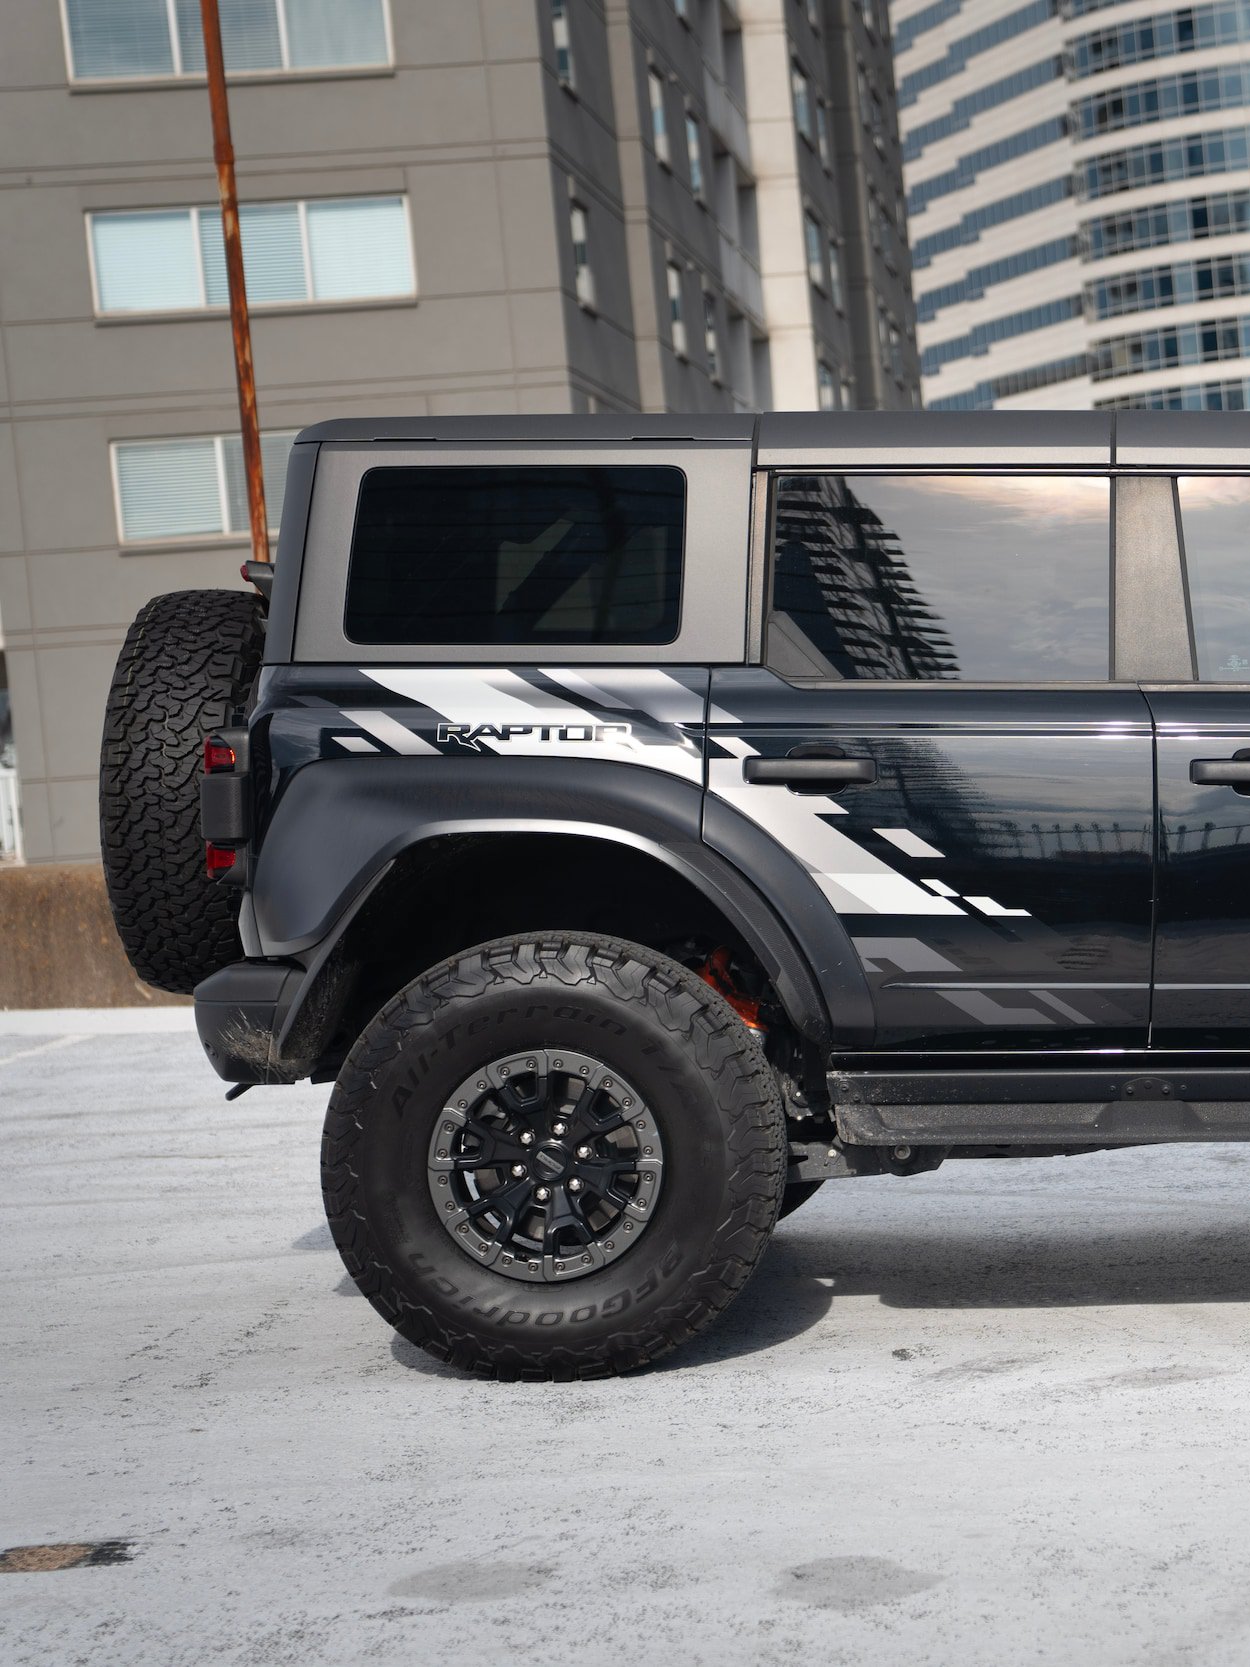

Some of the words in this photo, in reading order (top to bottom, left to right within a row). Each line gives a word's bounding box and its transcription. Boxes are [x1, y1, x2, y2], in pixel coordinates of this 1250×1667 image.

[437, 722, 637, 752] RAPTOR
[390, 1003, 627, 1118] All-Terrain
[407, 1241, 685, 1326] BFGoodrich
